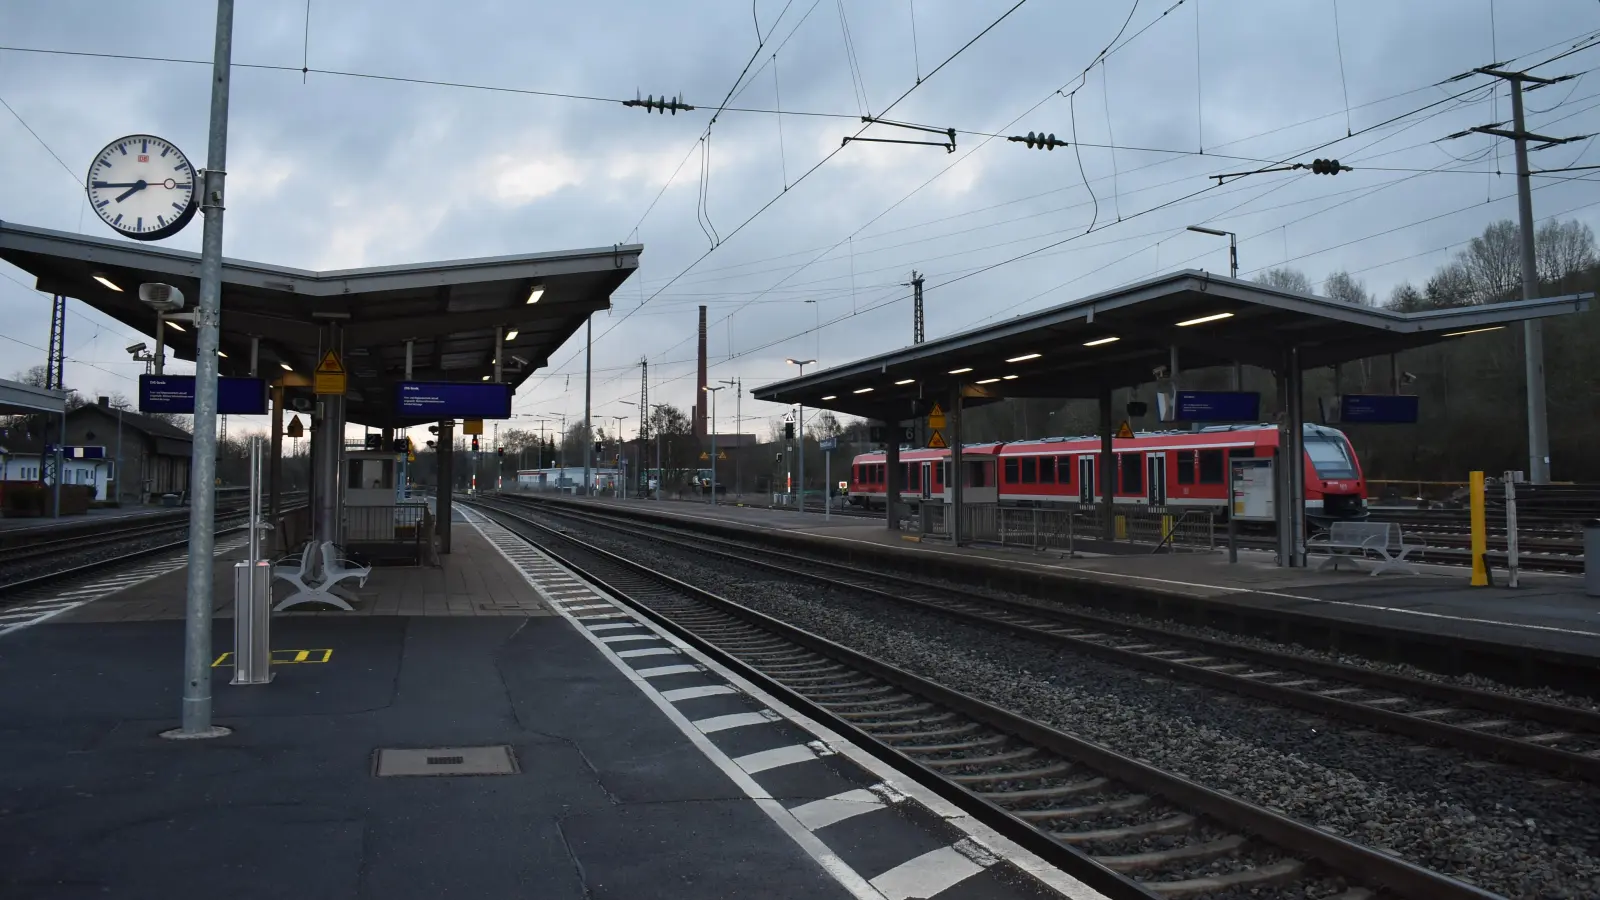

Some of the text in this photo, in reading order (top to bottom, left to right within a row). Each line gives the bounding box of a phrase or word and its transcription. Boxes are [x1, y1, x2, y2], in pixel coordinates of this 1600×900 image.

[905, 427, 914, 440] 6
[368, 435, 376, 445] 2
[400, 440, 408, 450] 3
